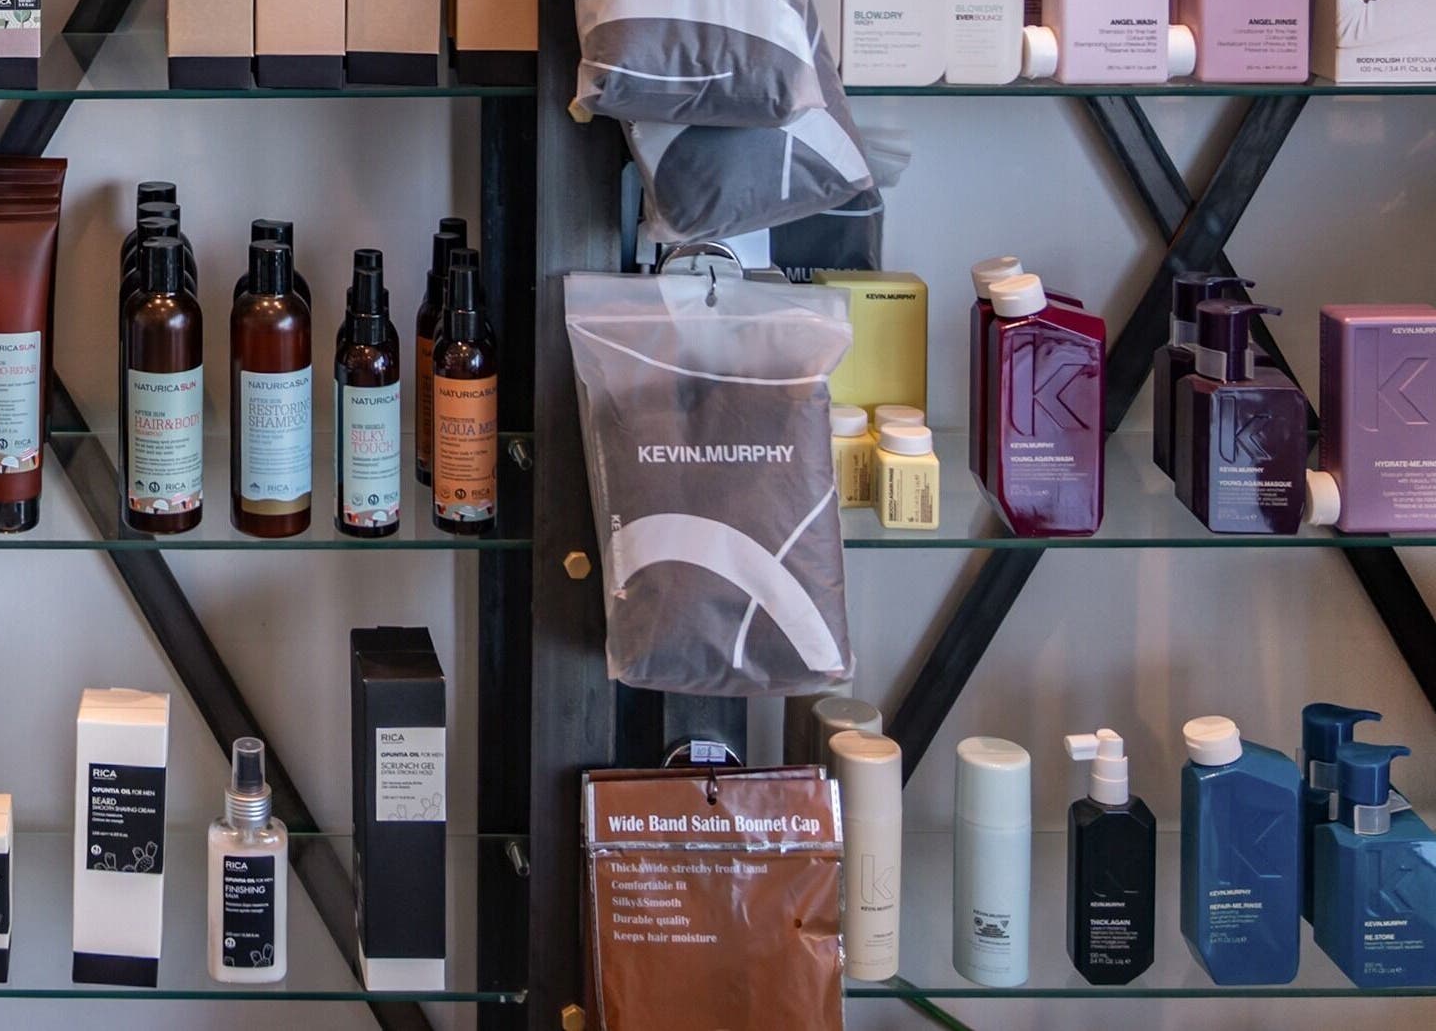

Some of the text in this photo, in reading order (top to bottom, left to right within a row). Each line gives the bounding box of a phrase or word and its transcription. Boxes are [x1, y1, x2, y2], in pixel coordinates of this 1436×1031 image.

[134, 380, 196, 393] NATURICASUN
[638, 445, 794, 463] KEVIN.MURPHY
[381, 733, 405, 742] RICA
[93, 769, 117, 778] RICA
[93, 797, 117, 805] BEARD
[609, 815, 820, 836] Wide Band Satin Bonnet Cap
[226, 861, 248, 869] RICA
[671, 863, 712, 874] stretchy
[225, 885, 265, 894] FINISHING
[611, 880, 686, 890] Comfortable fit
[612, 897, 681, 908] Silky&Smooth
[613, 914, 691, 927] Durable quality
[614, 931, 716, 944] Keeps hair moisture
